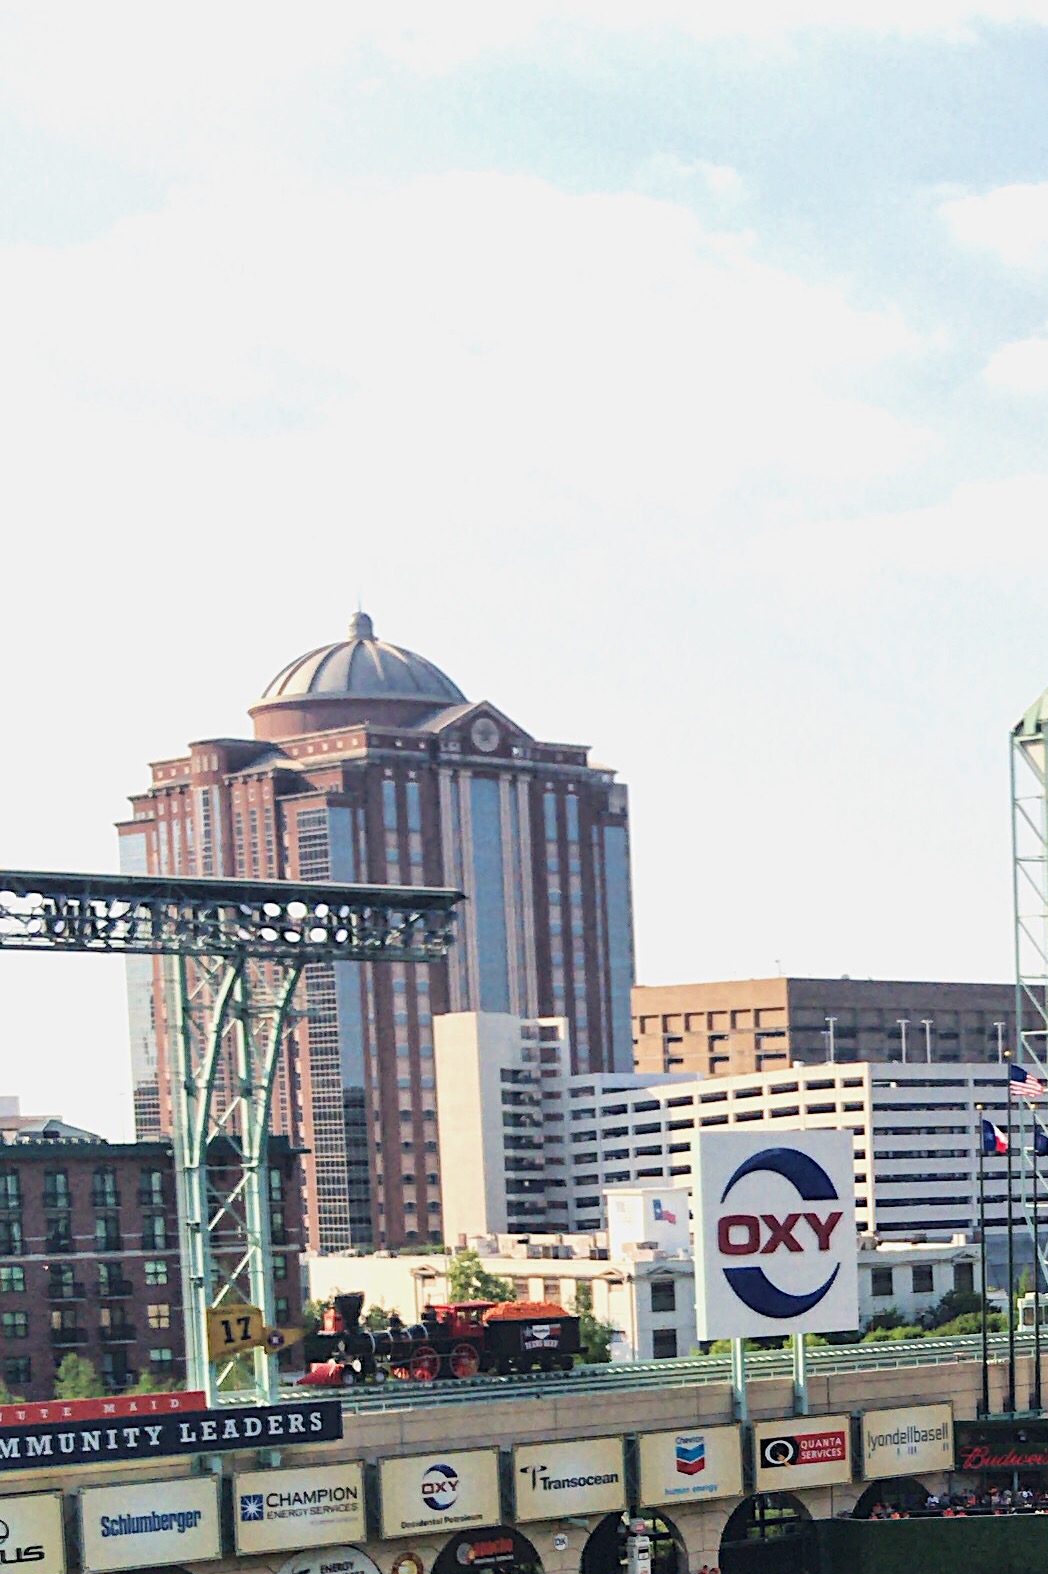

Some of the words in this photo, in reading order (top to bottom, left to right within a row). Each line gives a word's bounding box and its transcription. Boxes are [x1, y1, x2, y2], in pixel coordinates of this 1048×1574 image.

[717, 1211, 845, 1256] OXY
[221, 1316, 251, 1344] 17
[103, 1398, 180, 1413] MAID
[179, 1411, 323, 1443] LEADERS
[867, 1423, 949, 1451] lyondellbasell
[800, 1437, 842, 1450] QUANTA
[801, 1448, 842, 1459] SERVICES
[421, 1479, 460, 1495] OXY
[540, 1472, 619, 1492] Transocean
[266, 1487, 358, 1507] CHAMPION
[267, 1506, 309, 1519] ENERGY
[309, 1503, 358, 1516] SERVICES
[101, 1510, 201, 1538] Schlumberger
[320, 1562, 354, 1574] ENERGY
